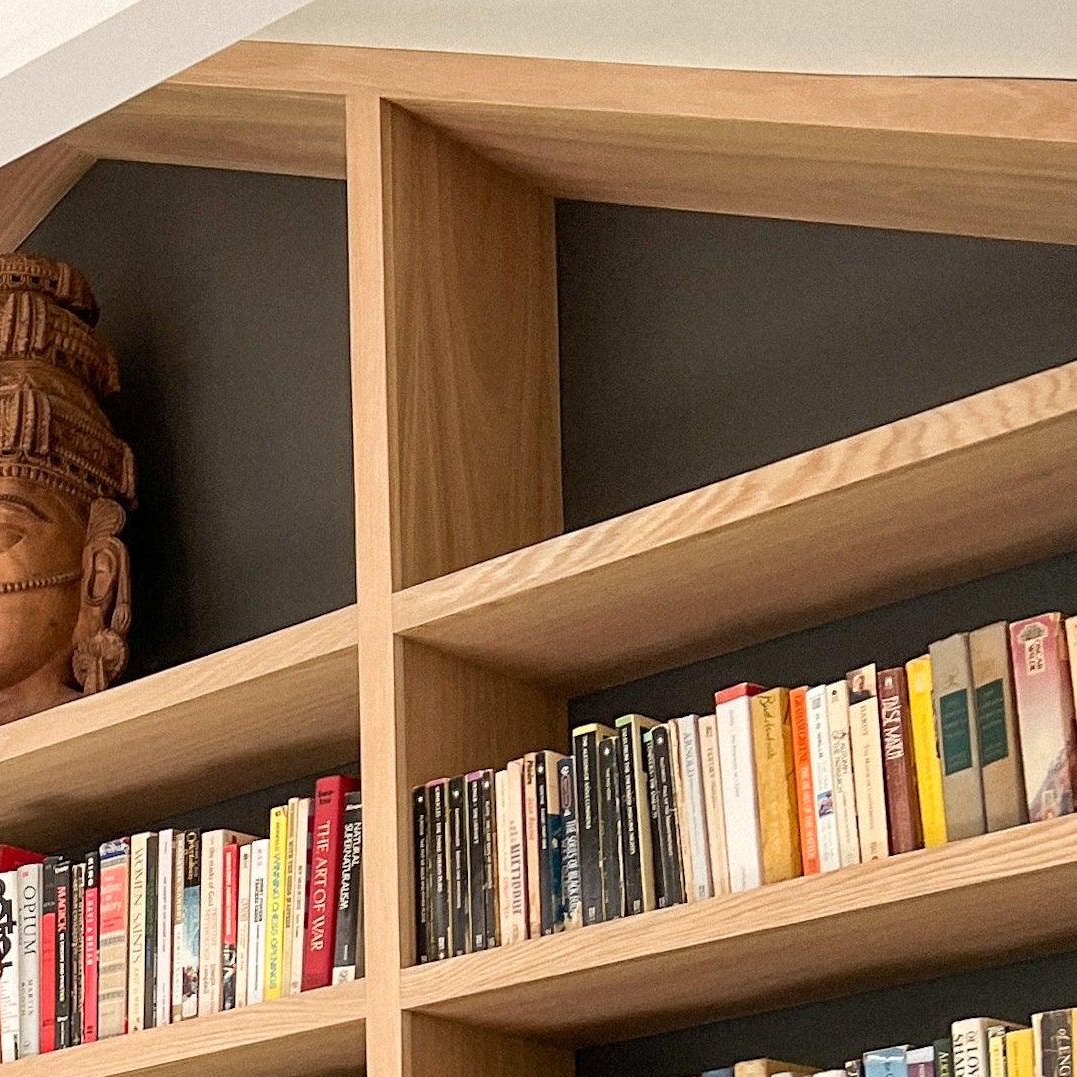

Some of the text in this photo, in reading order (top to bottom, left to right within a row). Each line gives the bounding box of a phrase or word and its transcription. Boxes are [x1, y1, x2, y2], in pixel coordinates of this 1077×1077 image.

[859, 704, 869, 737] HARDY
[683, 732, 695, 777] ARNOLD
[339, 822, 354, 910] SUPERNATURALISM
[351, 822, 362, 866] NATURAL
[57, 886, 67, 932] MAGICK
[132, 848, 144, 964] WOMEN SAINTS
[310, 820, 331, 952] THE ART OF WAR
[23, 885, 37, 956] OPIUM
[269, 852, 281, 990] WINNING CHESS OPENINGS
[1057, 1028, 1069, 1040] of
